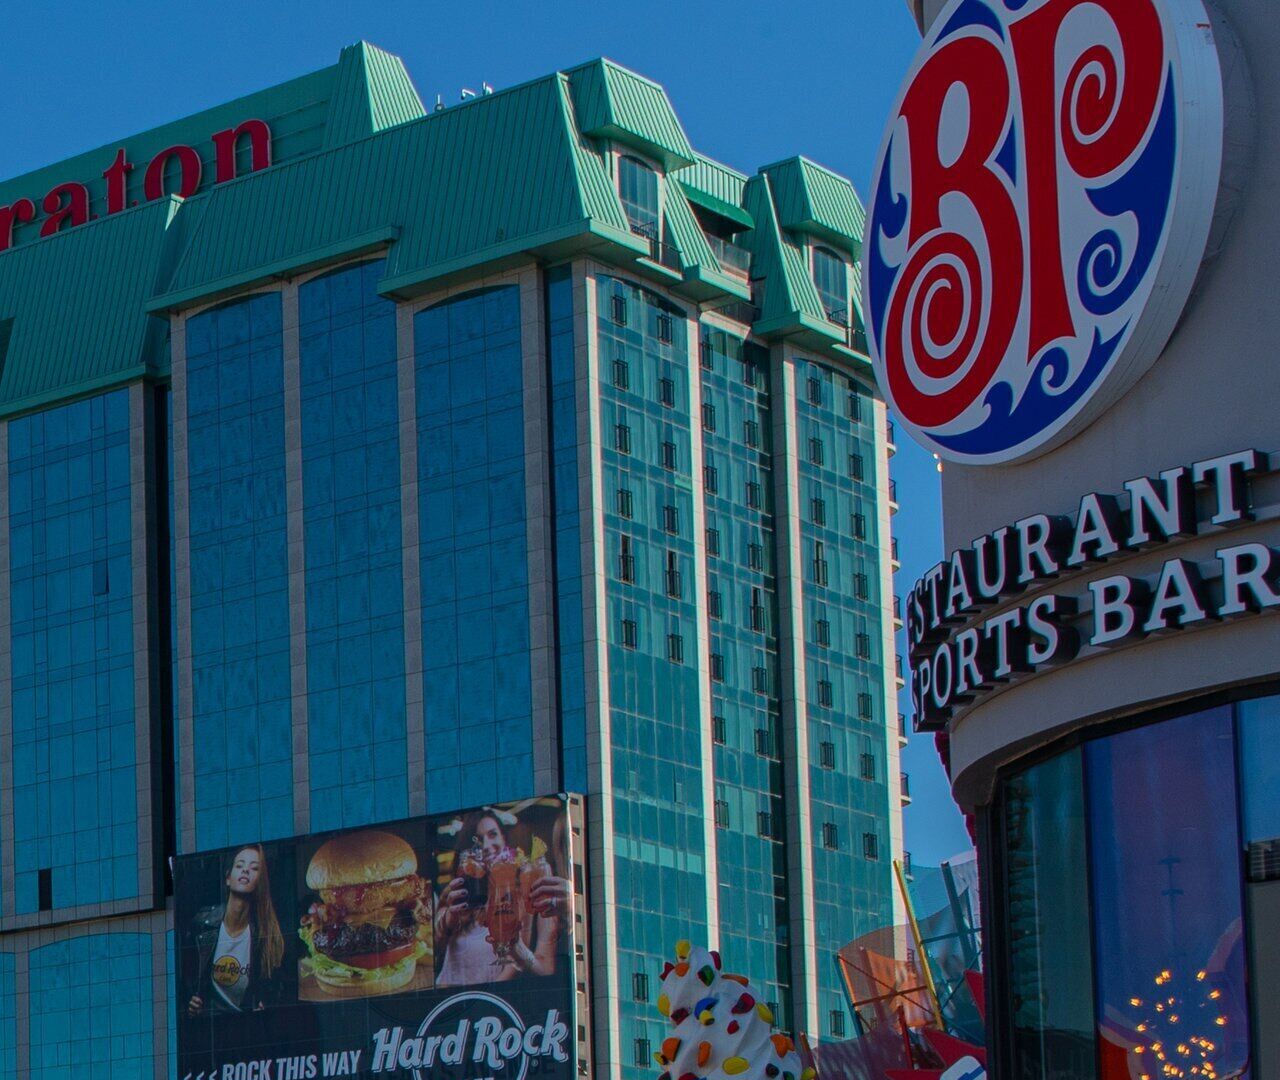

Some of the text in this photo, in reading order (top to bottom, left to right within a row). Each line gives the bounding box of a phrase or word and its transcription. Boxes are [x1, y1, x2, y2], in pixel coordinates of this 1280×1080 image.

[322, 1049, 361, 1078] WAY
[371, 1018, 469, 1073] Hard
[472, 1009, 570, 1071] Rock
